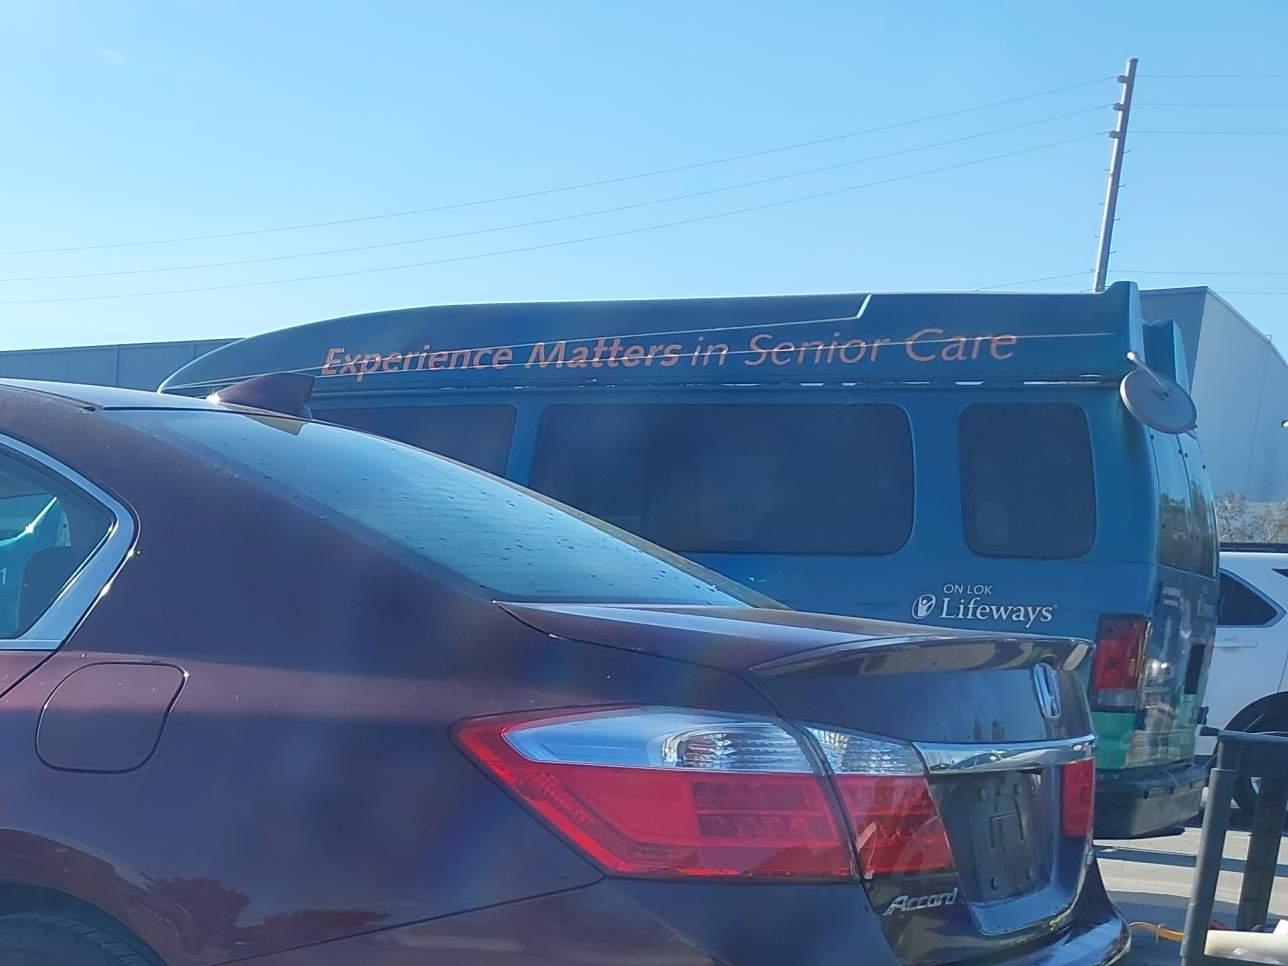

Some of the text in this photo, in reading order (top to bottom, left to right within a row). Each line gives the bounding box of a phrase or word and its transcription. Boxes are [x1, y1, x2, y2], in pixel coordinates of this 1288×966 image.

[320, 328, 1017, 382] Experience Matters in Senior Care
[943, 583, 993, 596] ON LOK
[939, 597, 1054, 629] Lifeways
[882, 887, 959, 916] Accord
